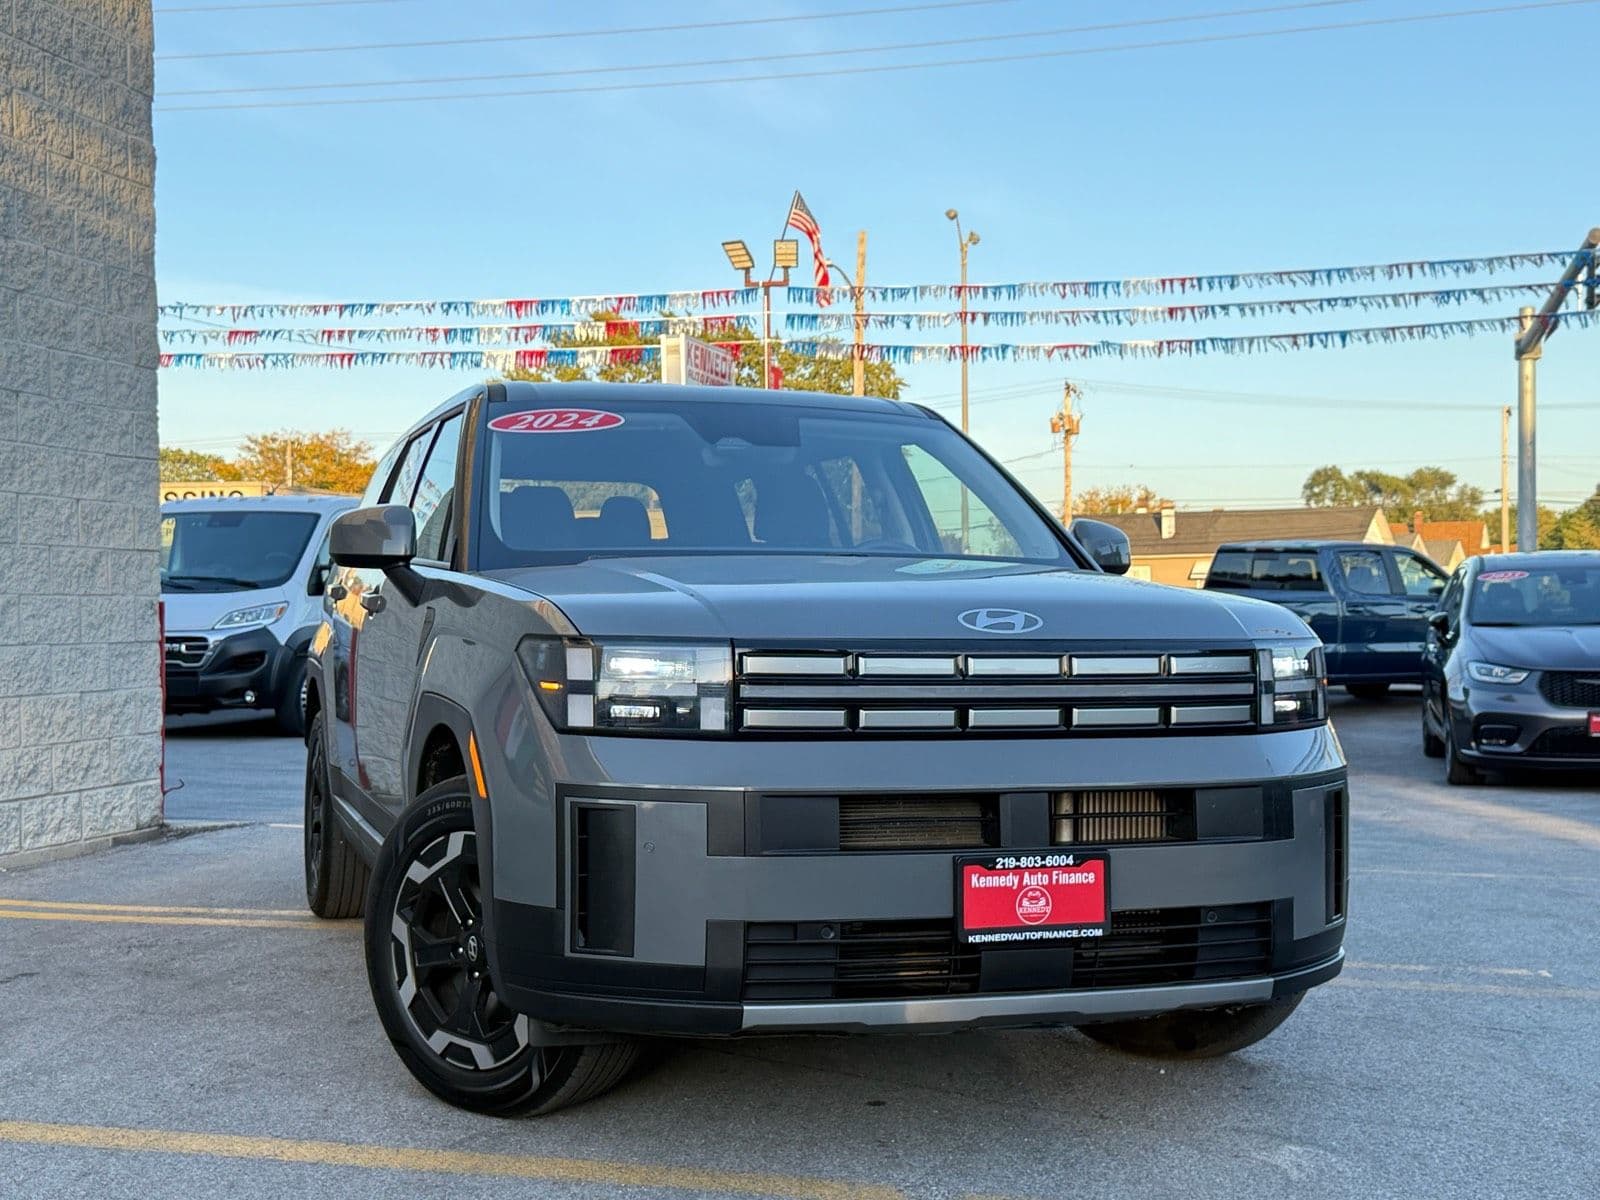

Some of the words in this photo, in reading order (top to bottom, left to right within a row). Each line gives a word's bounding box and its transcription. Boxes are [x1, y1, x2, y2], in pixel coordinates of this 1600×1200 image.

[508, 412, 603, 429] 2024
[995, 854, 1074, 869] 219-803-6004
[971, 873, 1019, 889] Kennedy
[1022, 871, 1049, 886] Auto
[1052, 870, 1096, 885] Finance
[968, 928, 1103, 943] KENNEDYAUTOFINANCE.COM
